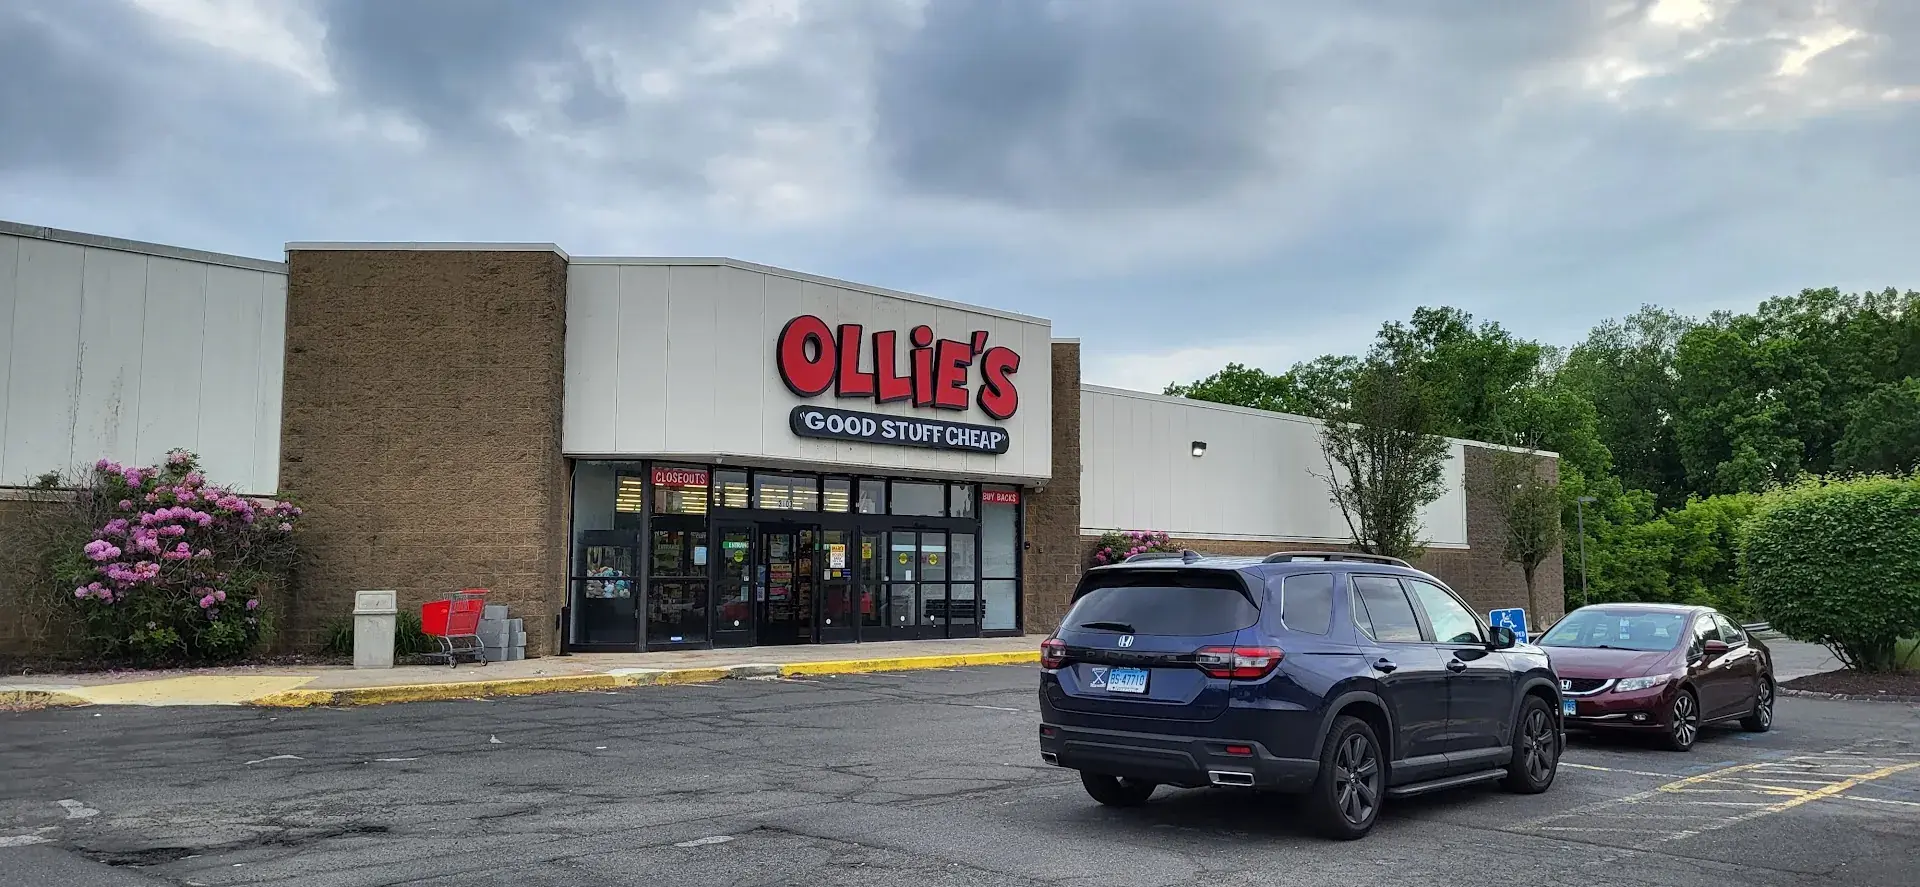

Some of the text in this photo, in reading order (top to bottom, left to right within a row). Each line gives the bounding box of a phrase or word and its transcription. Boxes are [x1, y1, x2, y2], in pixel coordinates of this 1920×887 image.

[881, 420, 944, 444] STUFF
[655, 471, 706, 485] CLOSEOUTS
[982, 492, 1016, 503] BUY BACKS
